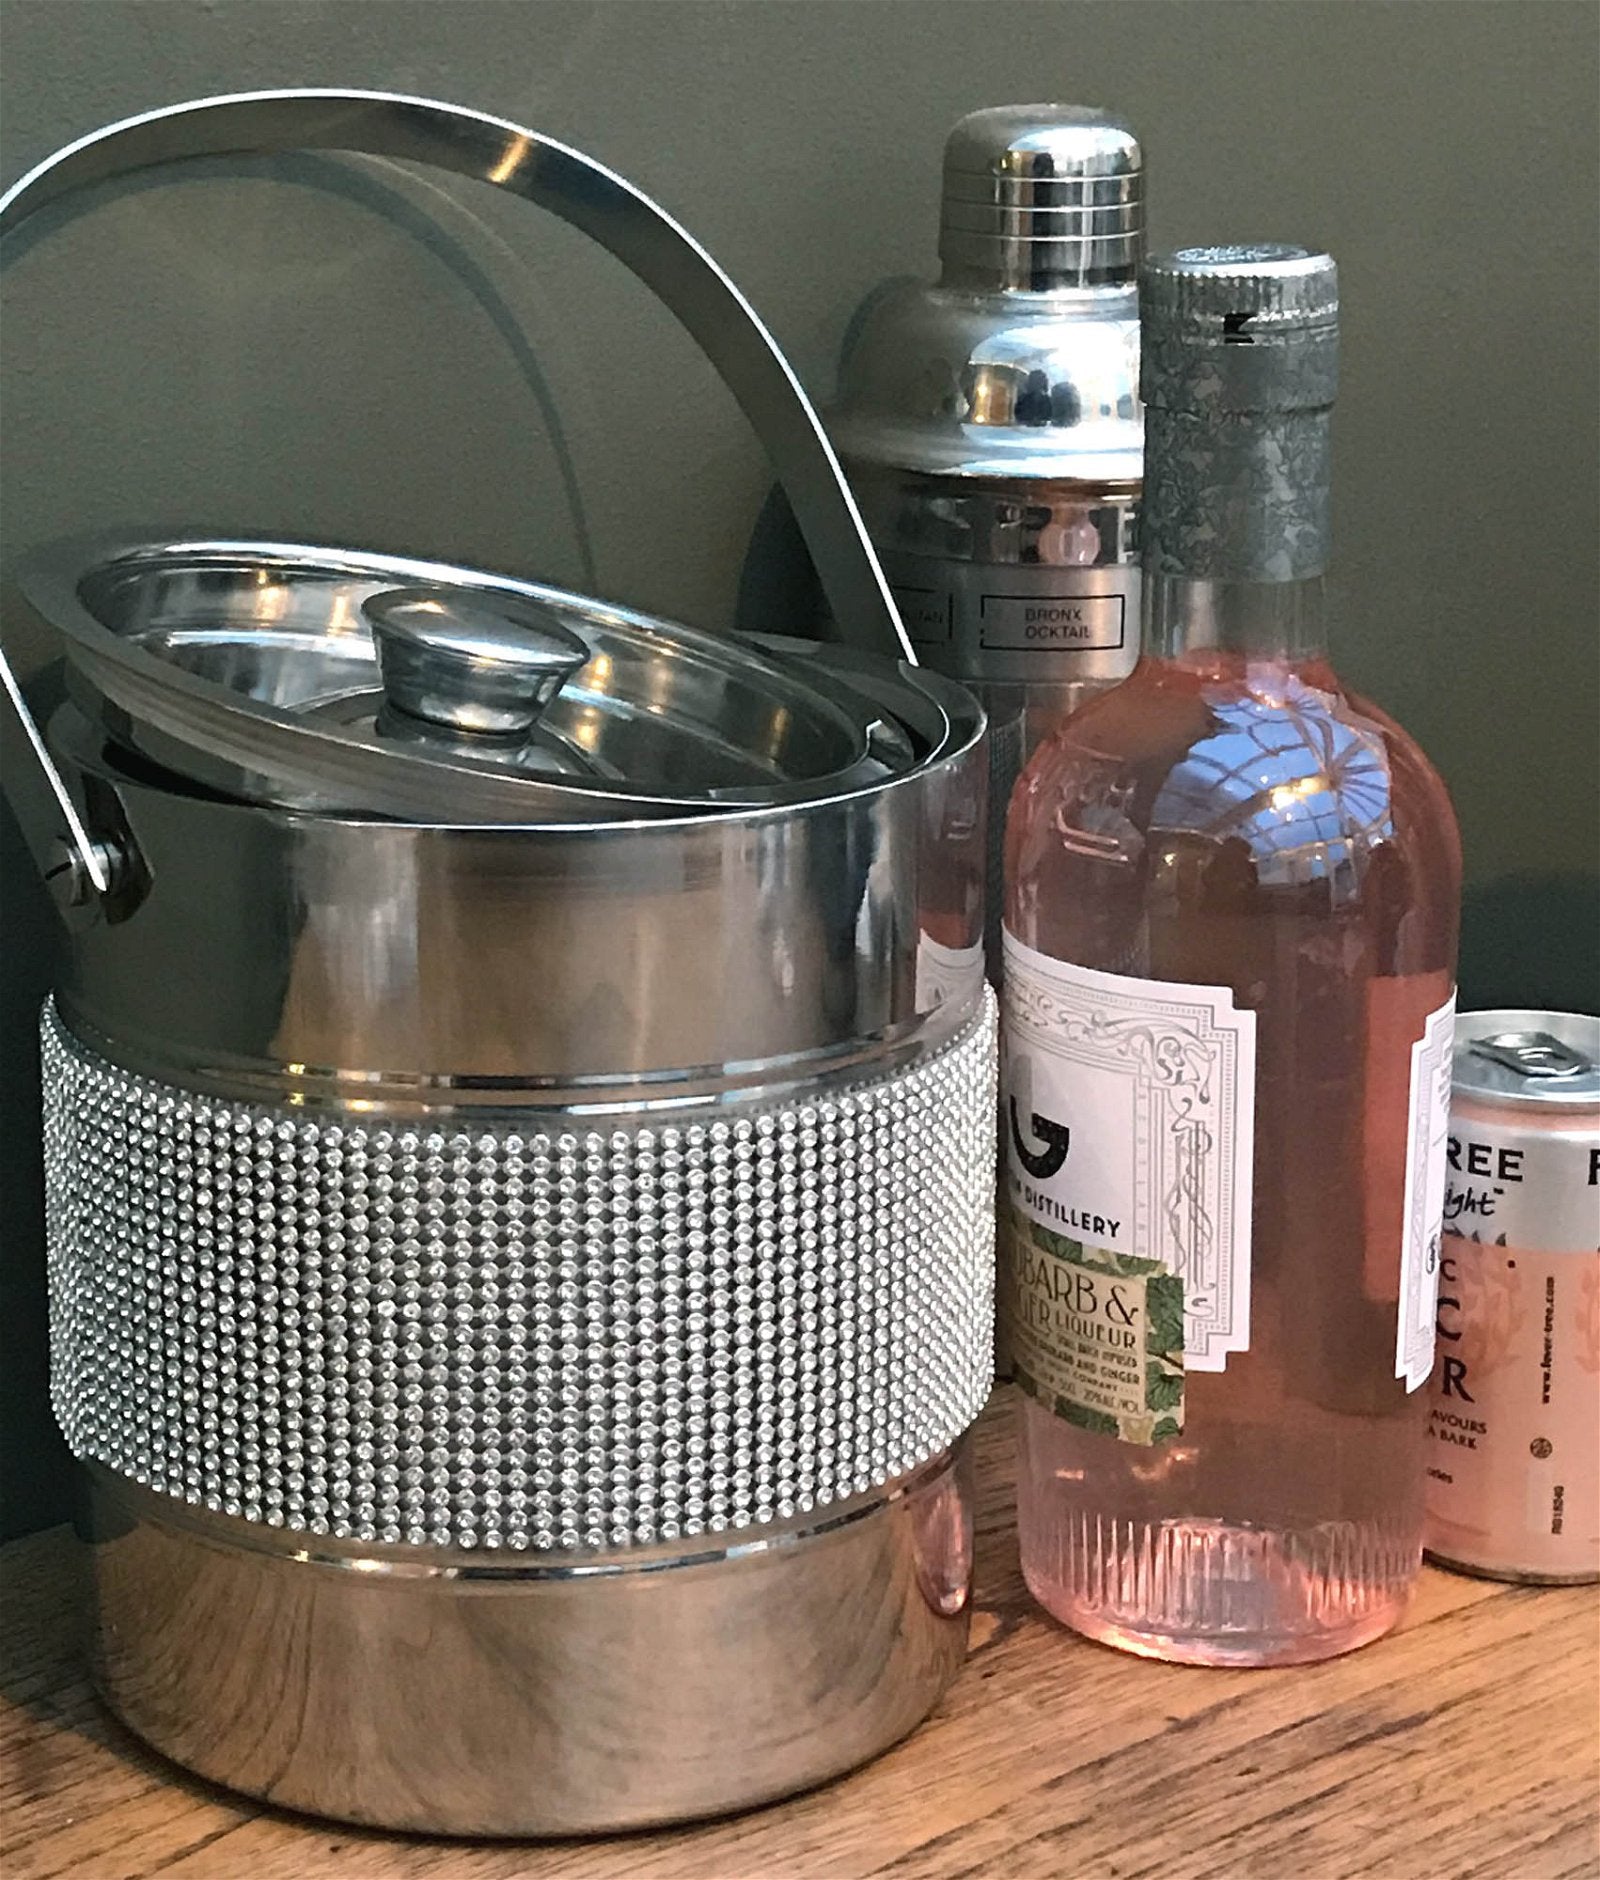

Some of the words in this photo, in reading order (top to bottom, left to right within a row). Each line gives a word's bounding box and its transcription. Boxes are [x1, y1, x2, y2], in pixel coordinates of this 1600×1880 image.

[1024, 608, 1082, 622] BRONX
[1025, 1185, 1121, 1238] DISTILLERY
[1105, 1284, 1139, 1327] &
[1056, 1310, 1137, 1349] LIQUEUR
[1100, 1366, 1140, 1385] GINGER
[1431, 1409, 1487, 1434] AVOURS
[1440, 1429, 1478, 1450] BARK
